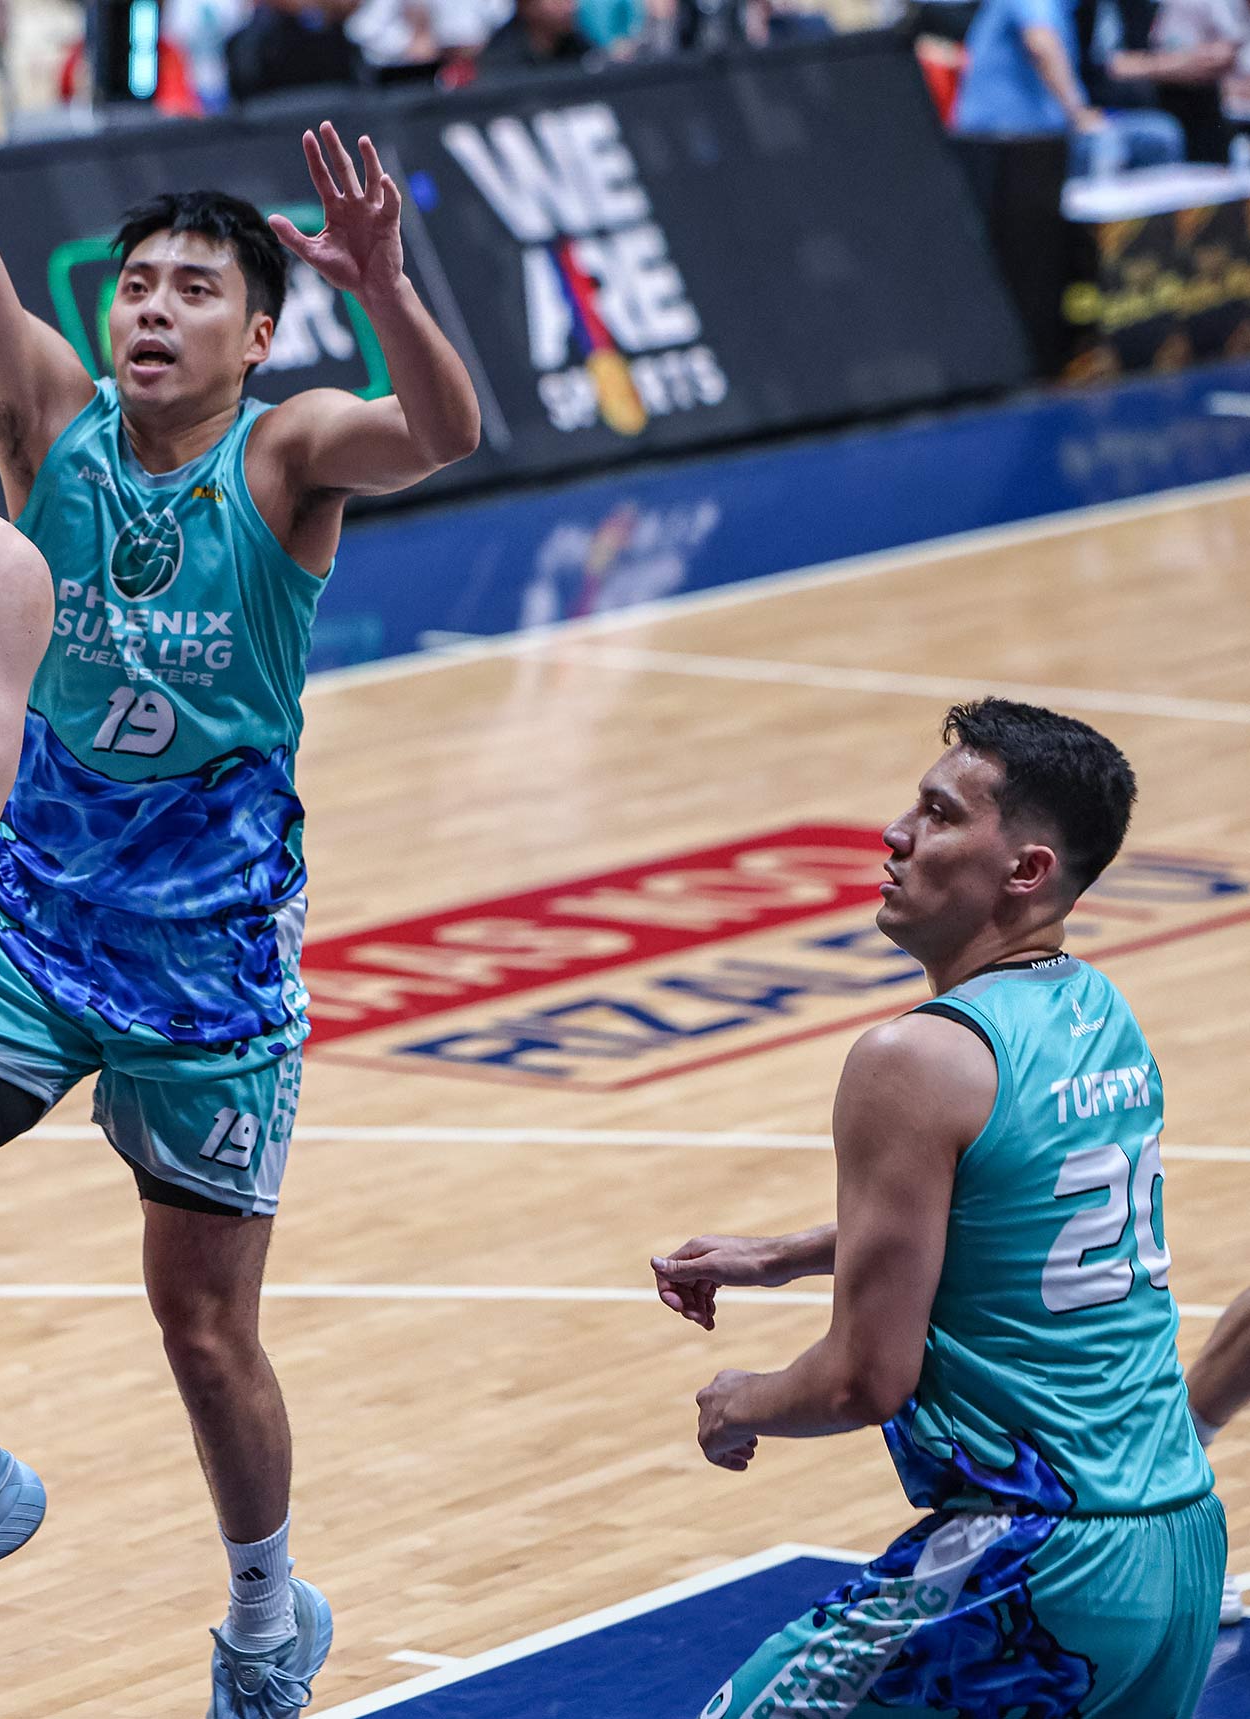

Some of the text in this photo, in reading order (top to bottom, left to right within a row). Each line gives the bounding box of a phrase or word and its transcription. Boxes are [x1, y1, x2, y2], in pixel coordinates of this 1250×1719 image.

[441, 103, 652, 243] WE
[522, 223, 703, 370] ARE
[66, 643, 123, 668] FUEL
[158, 639, 233, 670] LPG
[92, 685, 178, 758] 19
[1051, 1063, 1152, 1124] TUFFIN
[199, 1106, 260, 1171] 19
[1040, 1133, 1172, 1314] 20
